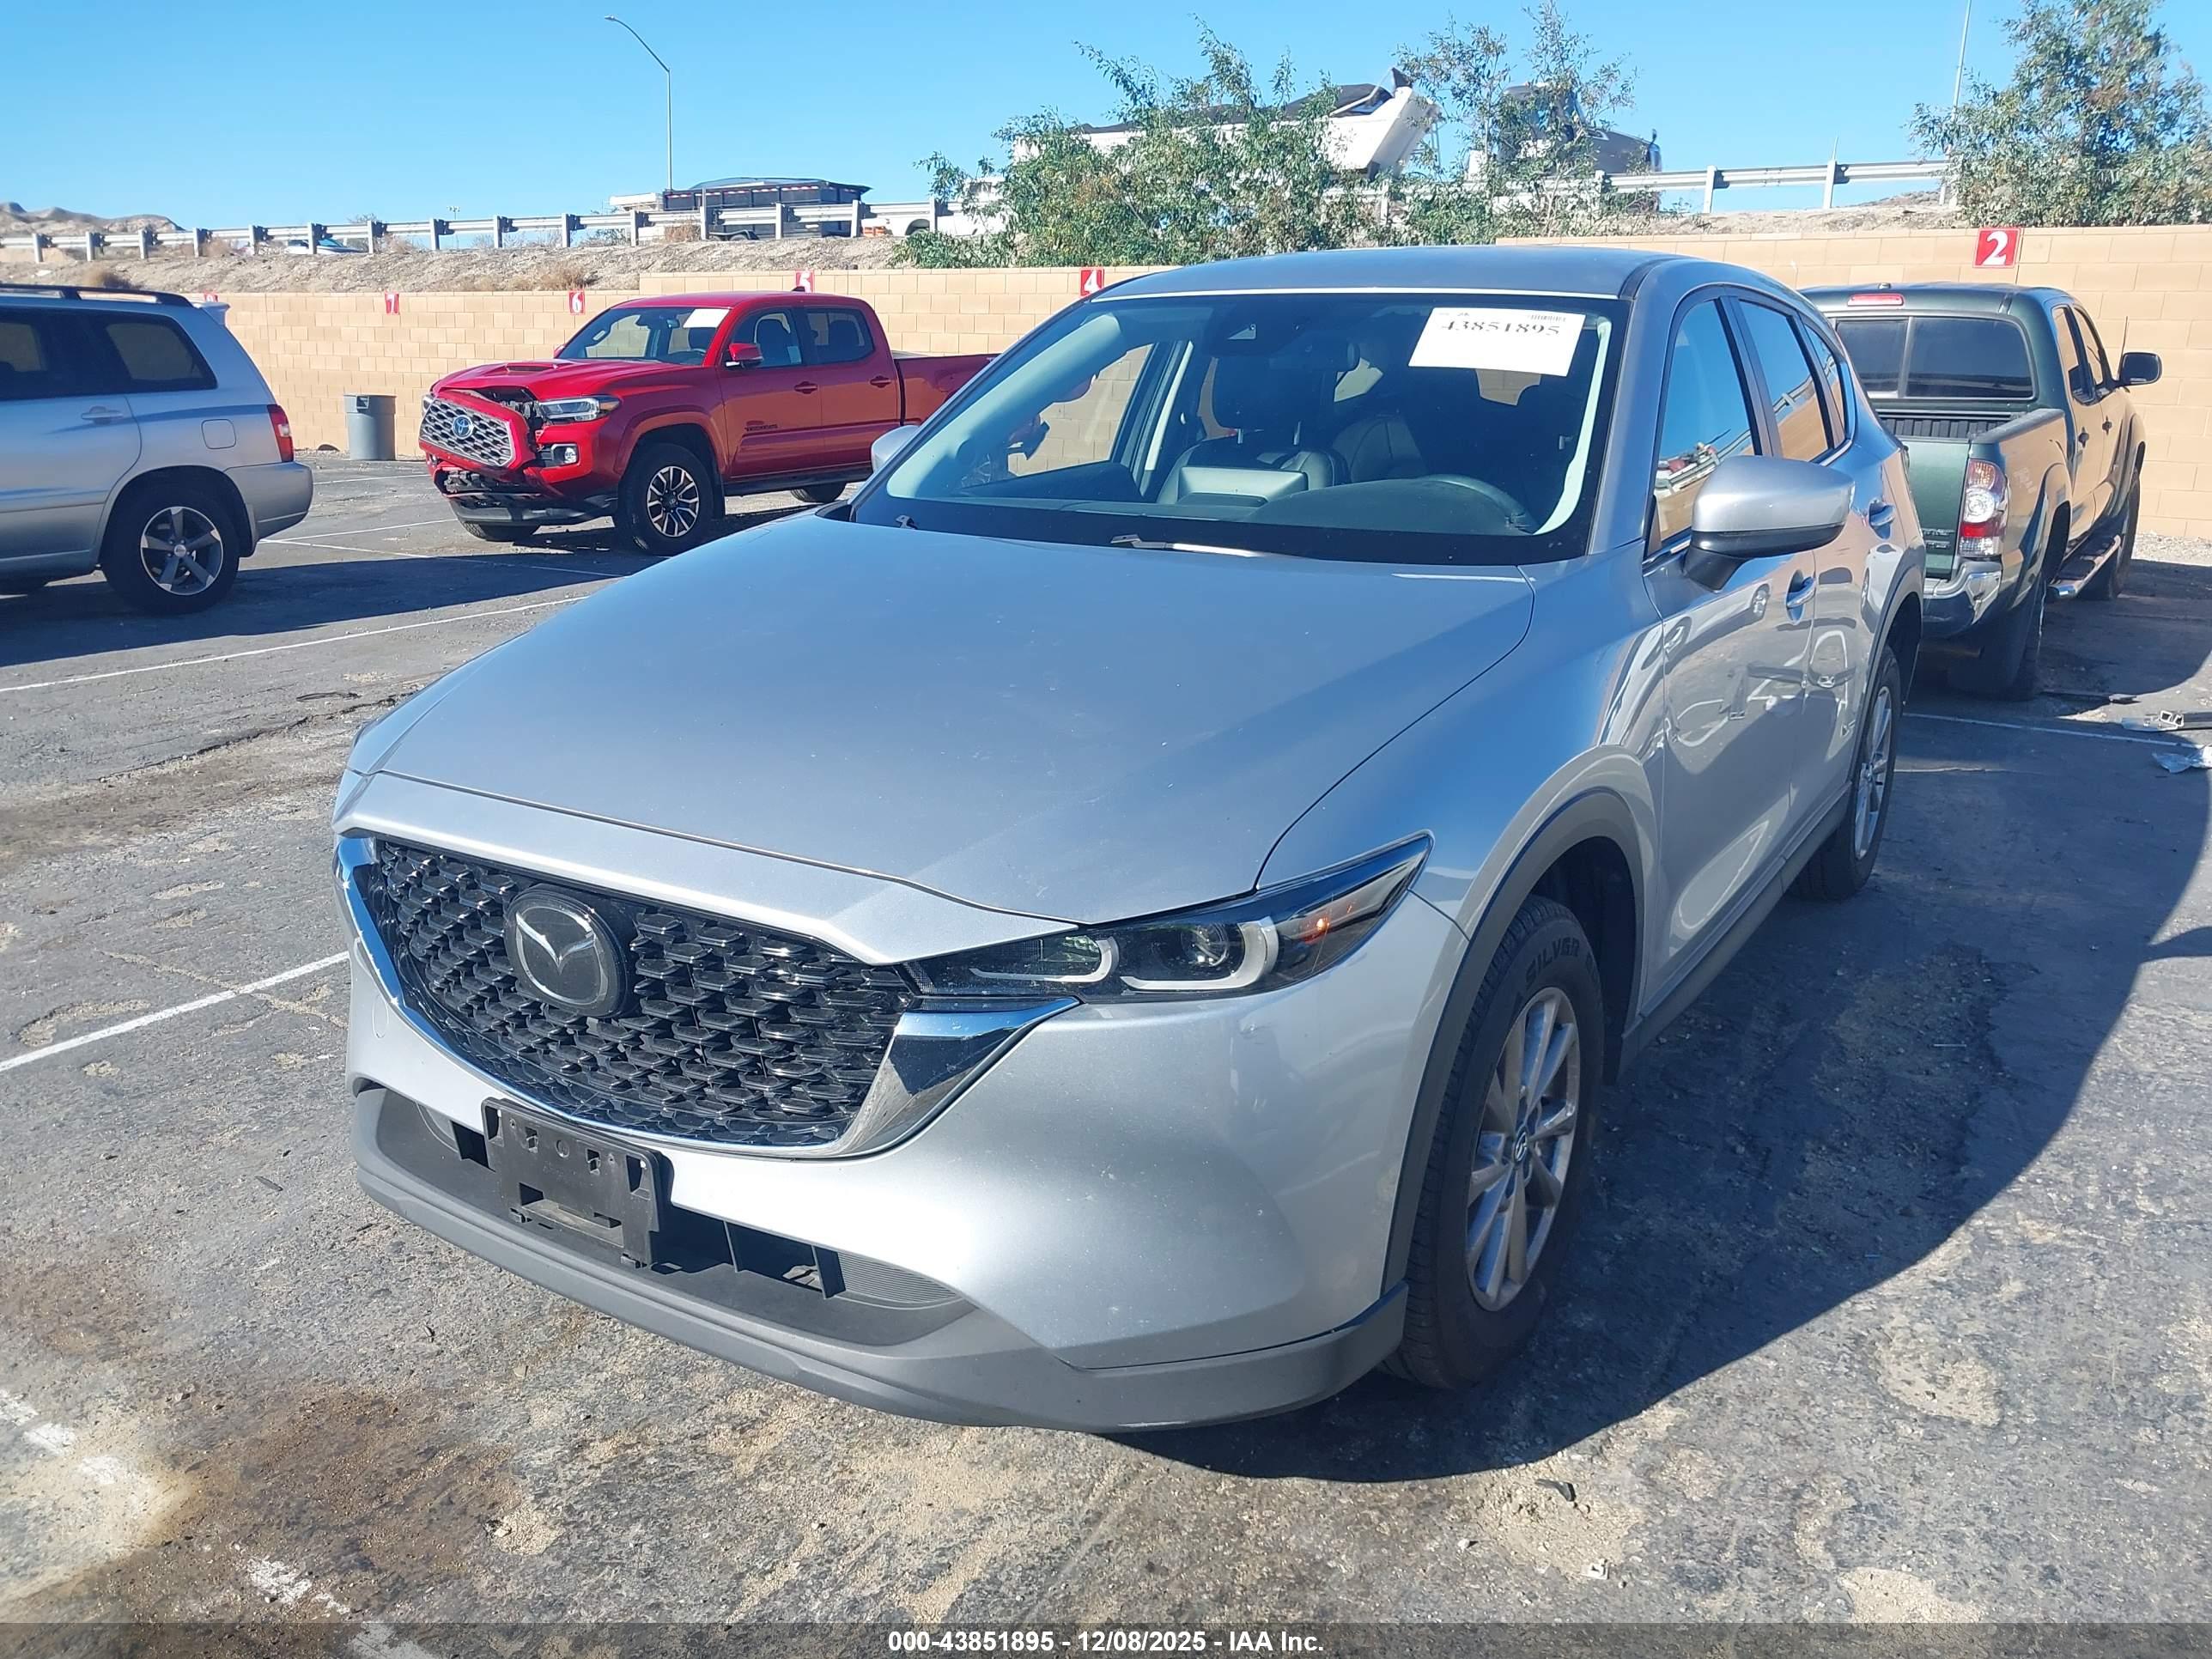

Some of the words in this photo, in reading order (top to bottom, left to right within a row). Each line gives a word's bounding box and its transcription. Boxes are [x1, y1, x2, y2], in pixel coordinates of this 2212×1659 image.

[1982, 230, 2008, 265] 2
[1084, 269, 1100, 294] 4
[386, 294, 396, 314] 7
[572, 292, 583, 313] 6
[1441, 320, 1560, 335] 43851895
